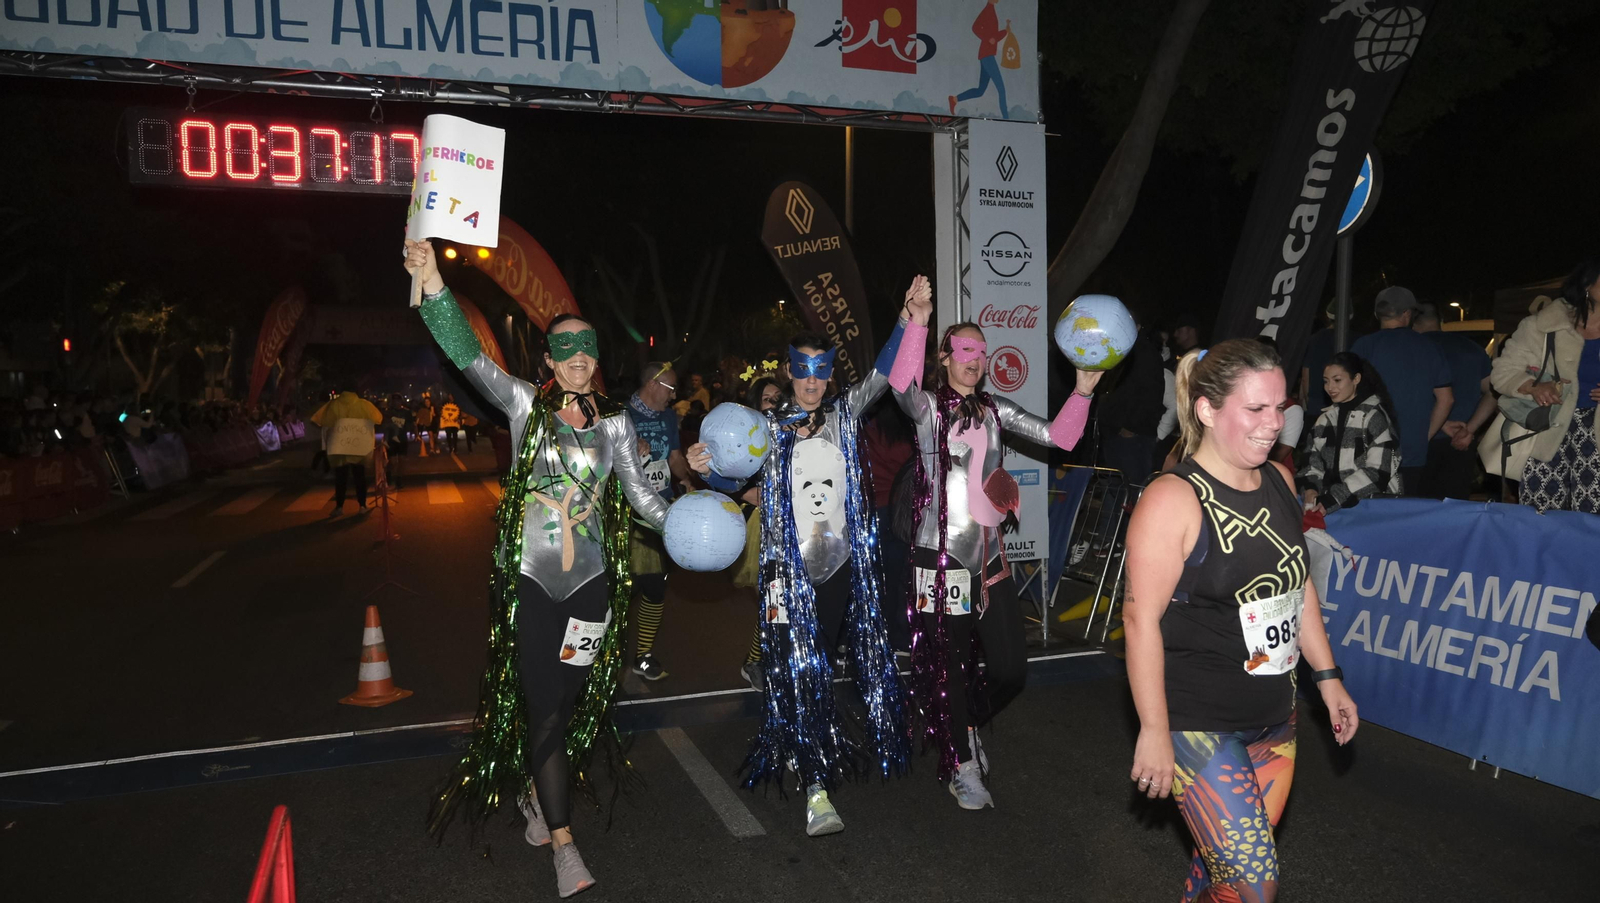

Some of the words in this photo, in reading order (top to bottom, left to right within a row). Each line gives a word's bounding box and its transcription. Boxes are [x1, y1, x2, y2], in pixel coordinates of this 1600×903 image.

[223, 0, 310, 43] DE
[979, 188, 1035, 201] RENAULT
[979, 199, 997, 207] SYRSA
[998, 200, 1034, 209] AUTOMOCION
[981, 249, 1033, 259] NISSAN
[1003, 540, 1036, 552] AULT
[1006, 551, 1036, 560] TOMOCION
[1341, 610, 1561, 702] ALMERÍA
